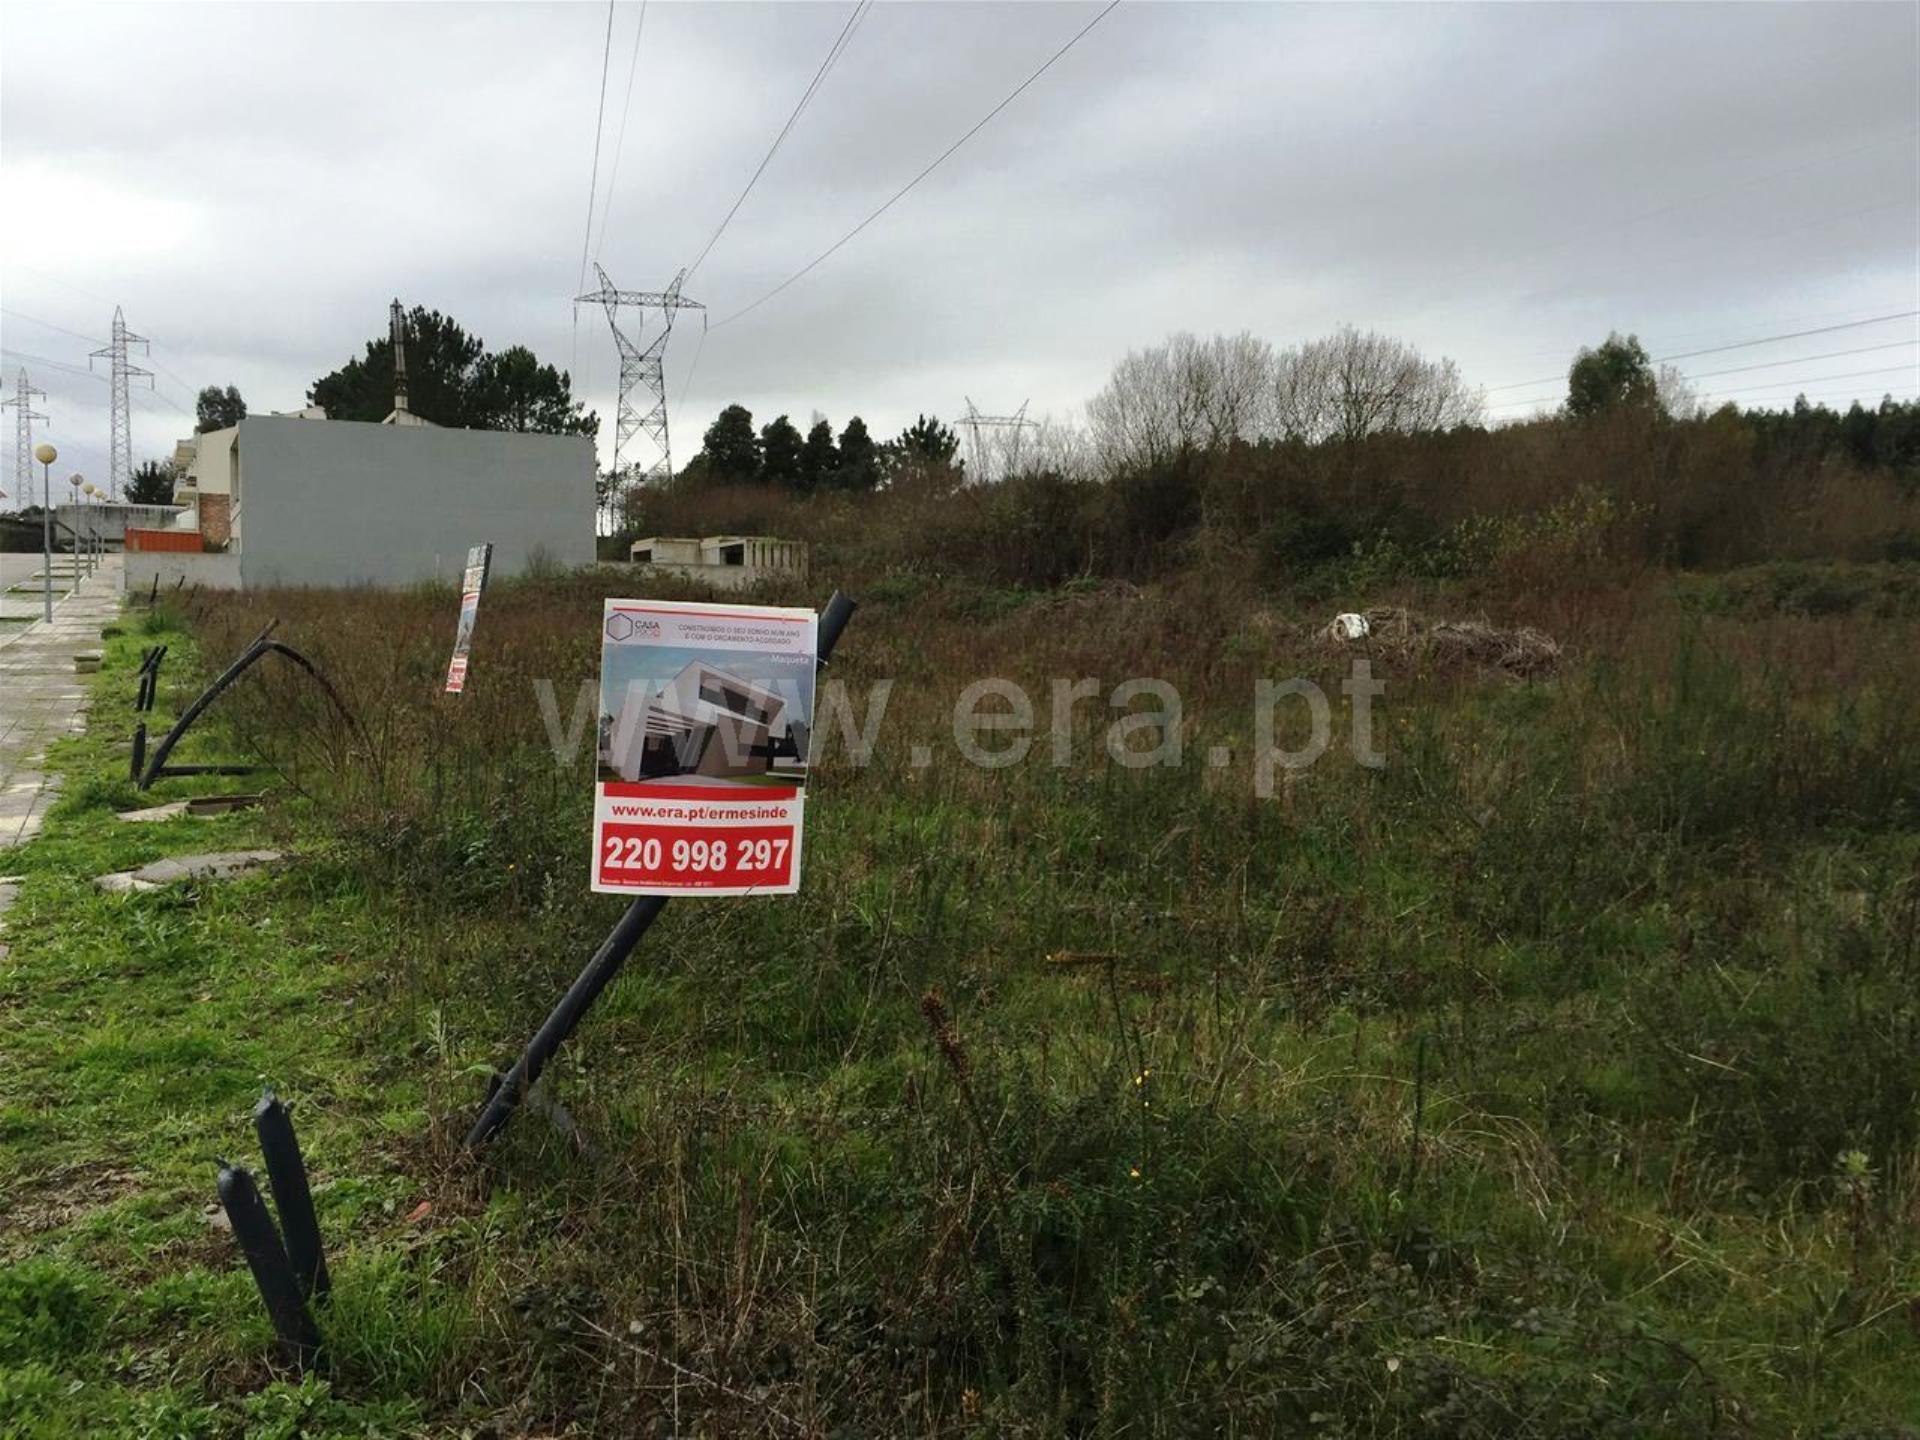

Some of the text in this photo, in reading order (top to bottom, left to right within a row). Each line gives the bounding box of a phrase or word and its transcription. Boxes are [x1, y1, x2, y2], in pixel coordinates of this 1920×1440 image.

[635, 620, 660, 630] CASA
[612, 805, 788, 822] www.era.pt/ermesinde
[604, 836, 789, 871] 220 998 297
